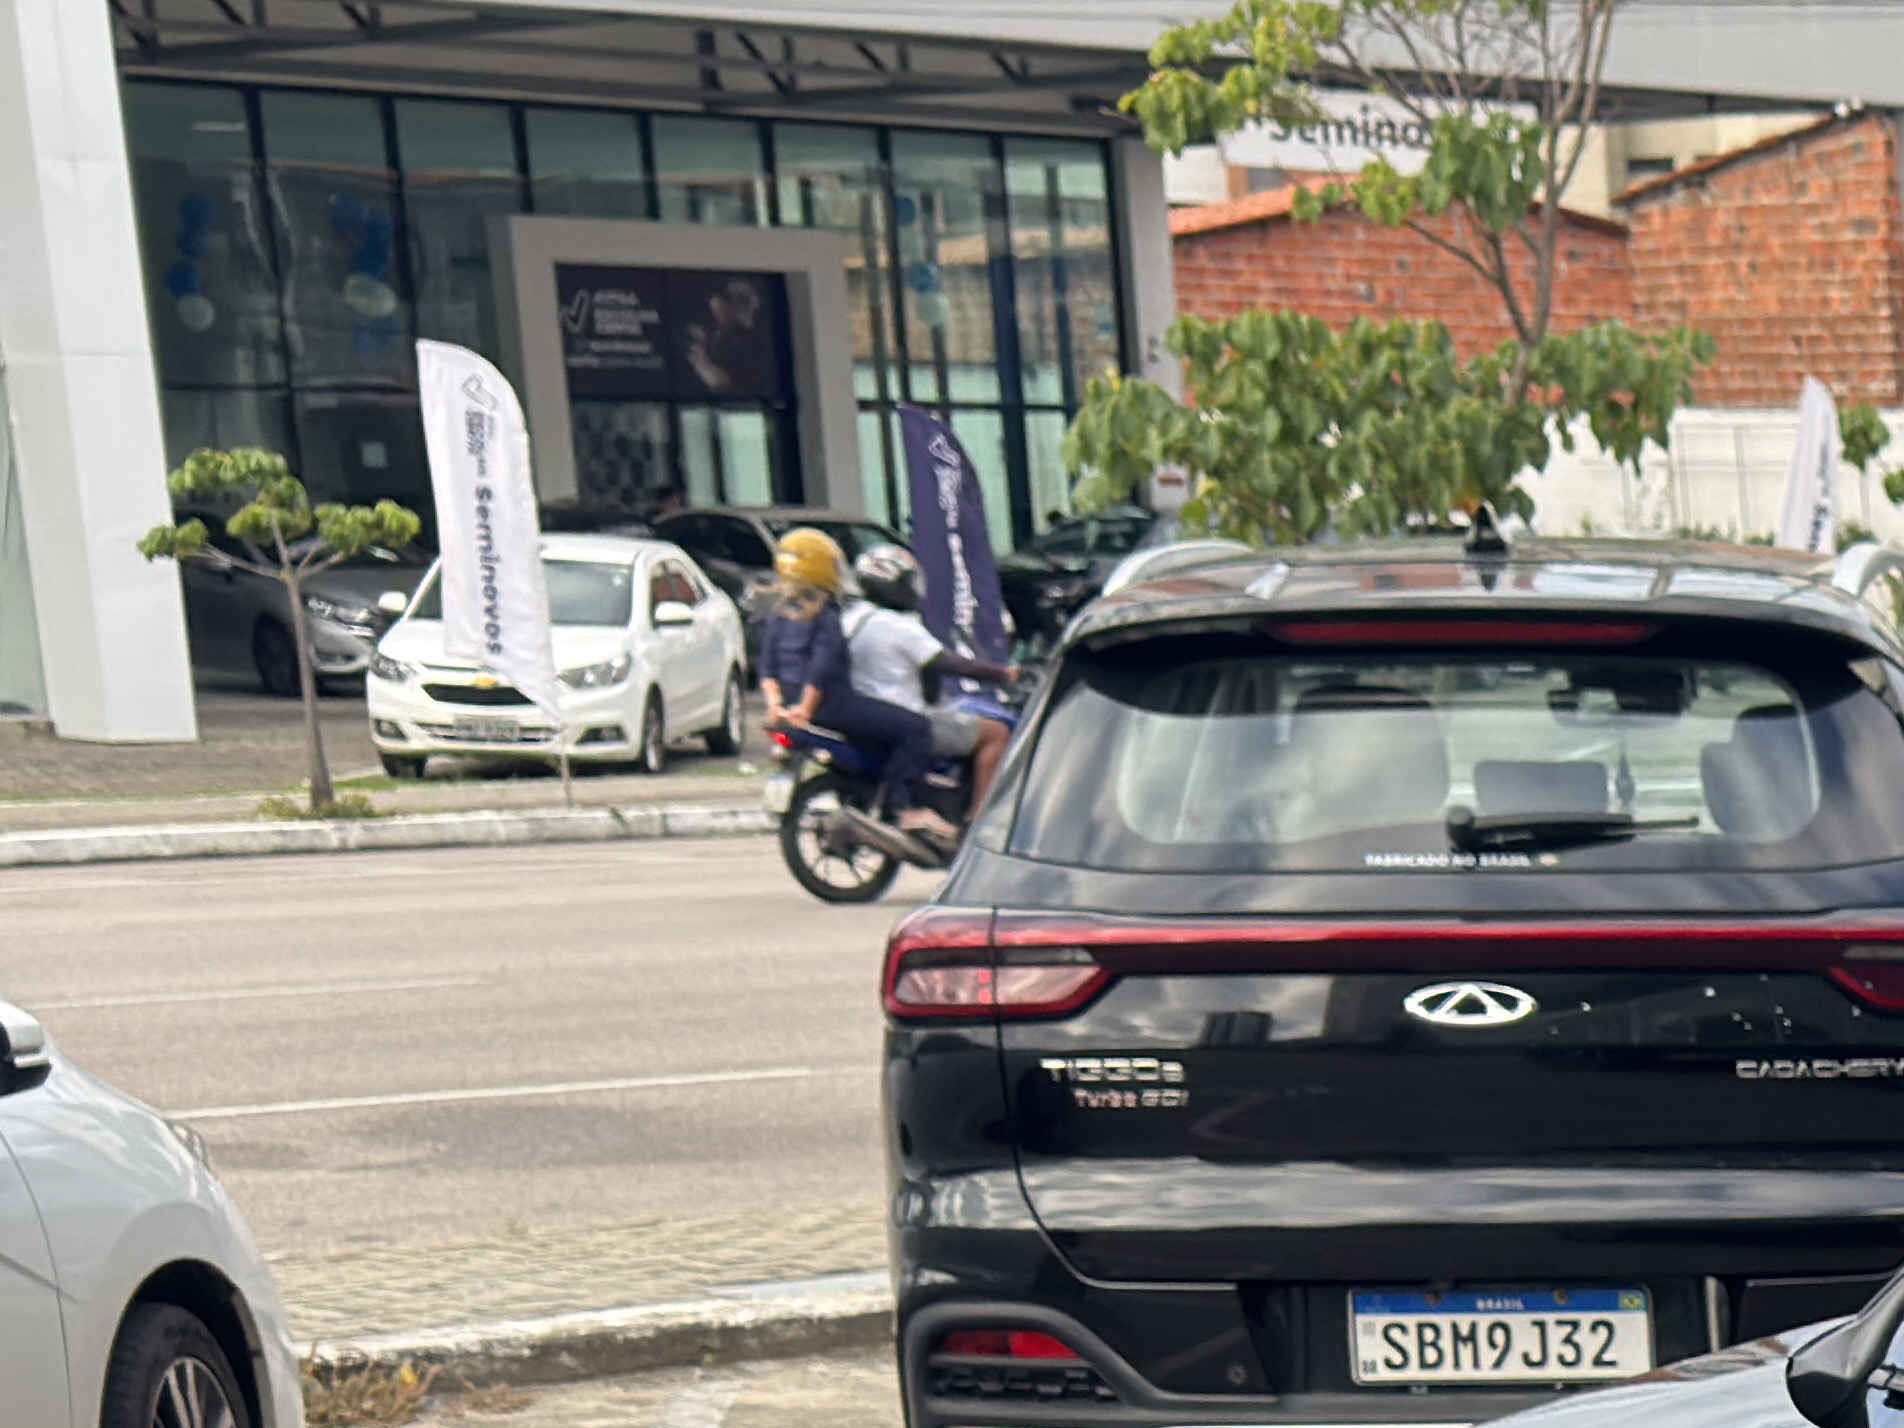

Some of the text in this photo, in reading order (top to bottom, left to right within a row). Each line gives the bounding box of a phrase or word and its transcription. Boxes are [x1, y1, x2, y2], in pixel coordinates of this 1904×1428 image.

[474, 485, 504, 657] Seminovos
[1475, 1298, 1525, 1312] BRASIL
[1381, 1319, 1618, 1372] SBM9J32
